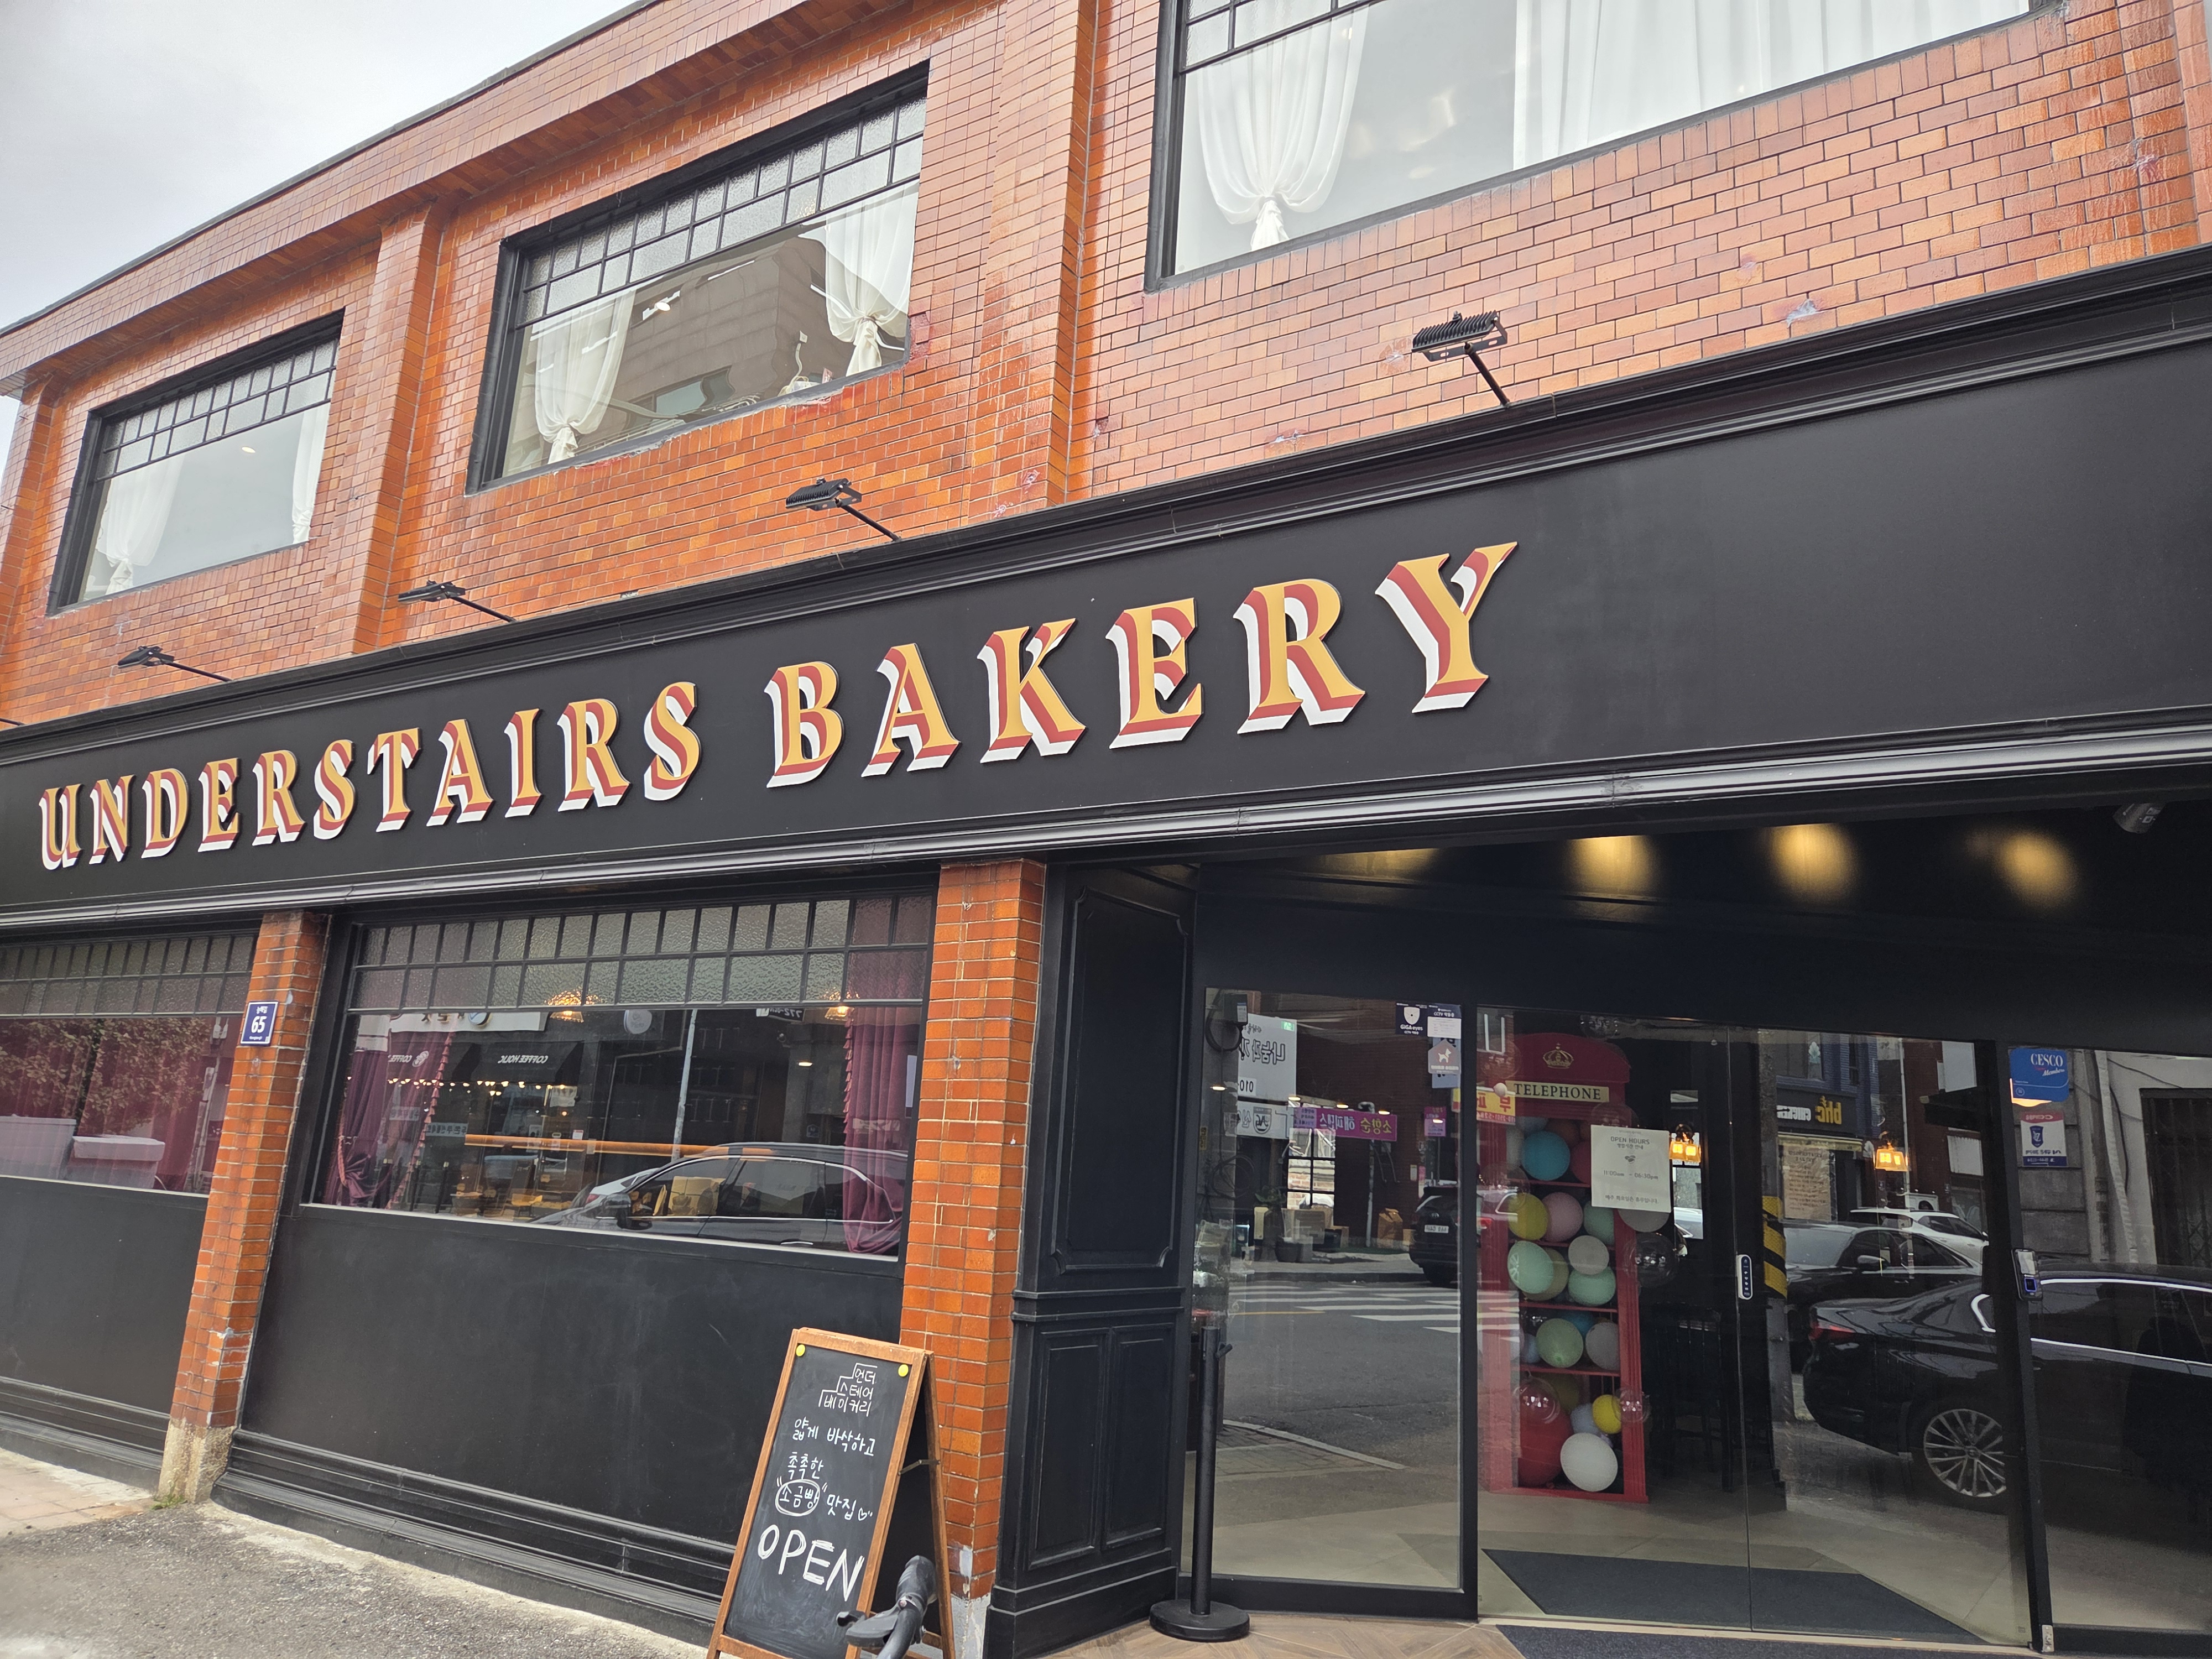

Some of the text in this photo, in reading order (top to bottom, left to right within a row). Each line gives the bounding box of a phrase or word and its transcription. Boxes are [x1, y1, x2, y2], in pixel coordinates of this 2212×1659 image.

[38, 541, 1518, 871] UNDERSTAIRS BAKERY
[251, 1015, 267, 1034] 65
[2031, 1053, 2063, 1067] CESCO
[1514, 1083, 1601, 1100] TELEPHONE
[1634, 1172, 1658, 1180] 06:30pm
[854, 1368, 877, 1384] 언더
[837, 1381, 874, 1399] 스테어
[824, 1394, 872, 1417] 베이커리
[792, 1417, 876, 1457] 얇게 바삭하고
[787, 1452, 824, 1480] 촉촉한
[826, 1493, 857, 1520] 맛집
[758, 1525, 865, 1601] OPEN
